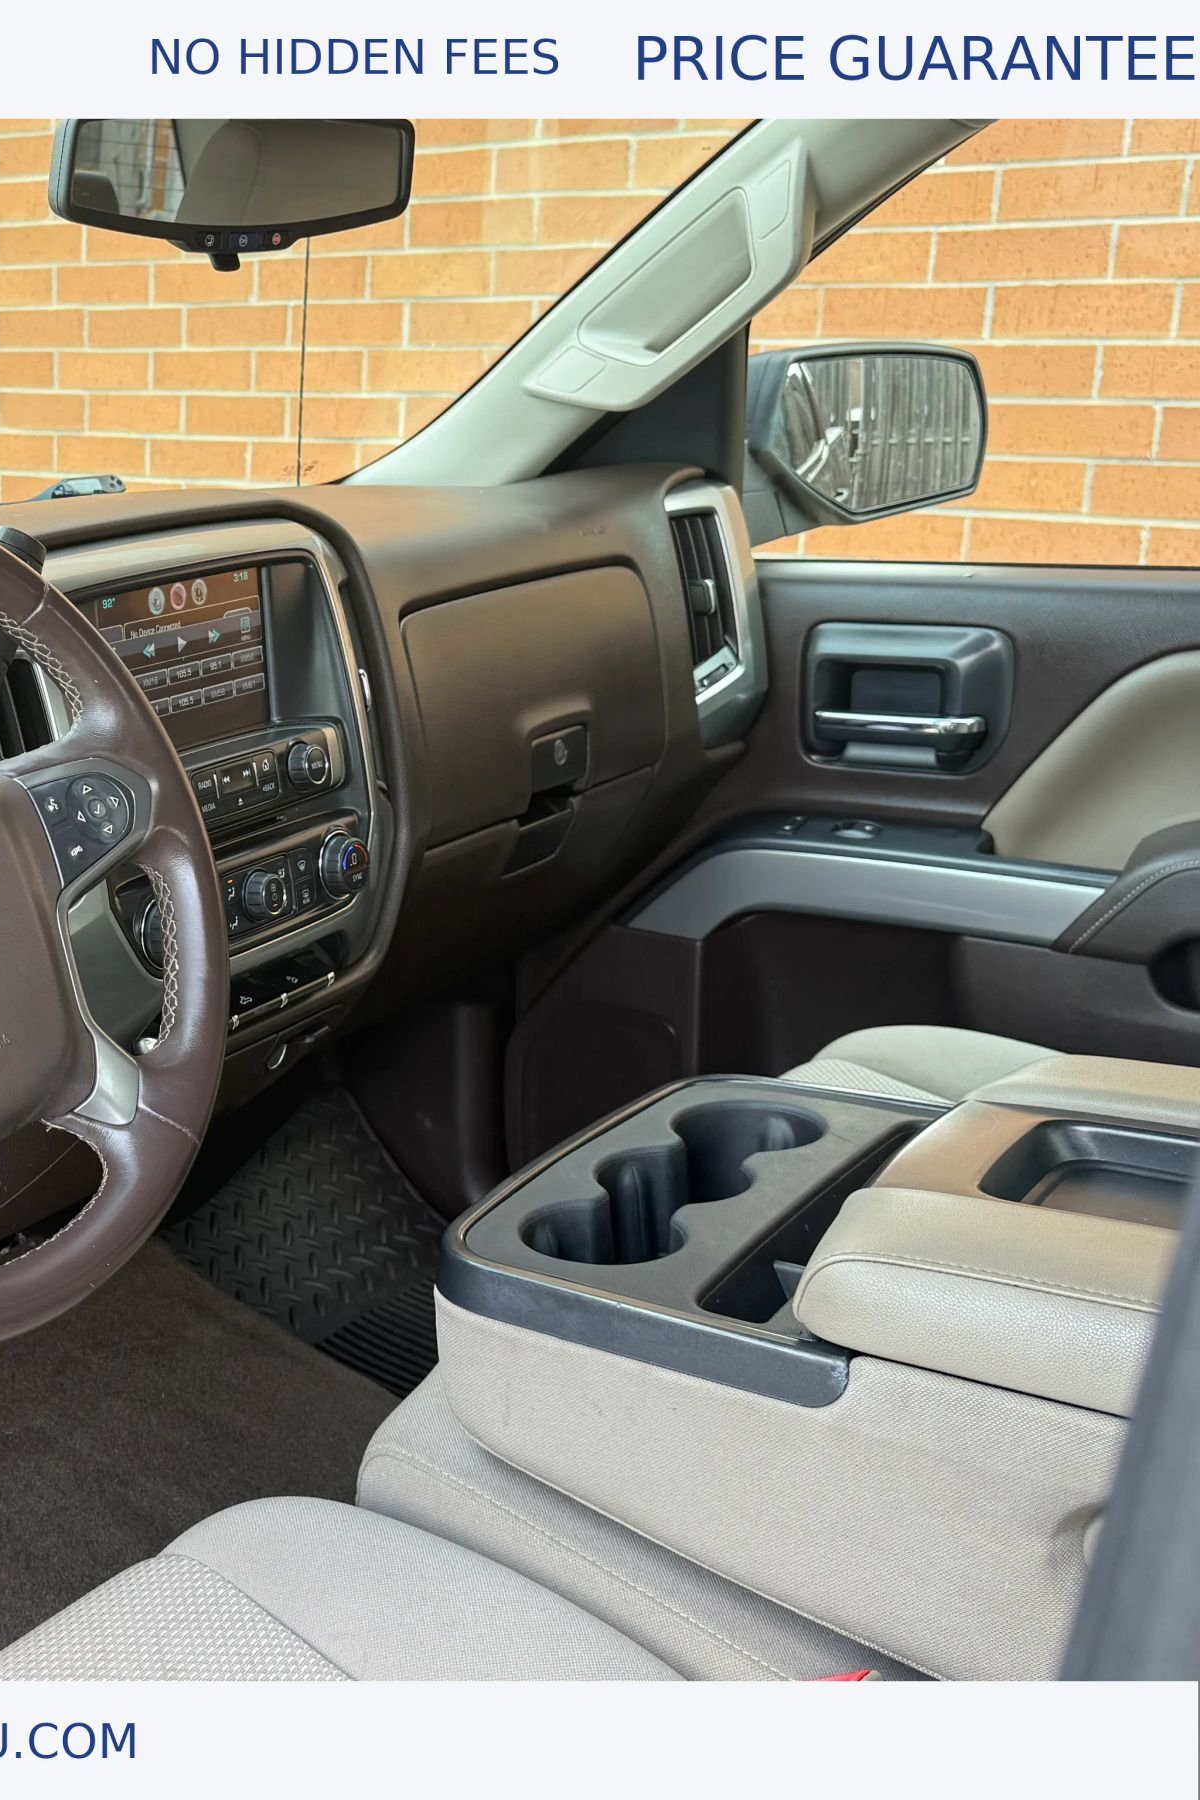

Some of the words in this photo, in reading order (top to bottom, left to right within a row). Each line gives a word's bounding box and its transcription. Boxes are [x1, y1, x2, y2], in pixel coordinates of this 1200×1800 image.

[130, 630, 139, 639] No
[139, 627, 156, 637] Device
[155, 620, 181, 634] Connected
[311, 761, 324, 770] MENU
[197, 780, 213, 790] RADIO
[201, 803, 216, 813] MEDIA
